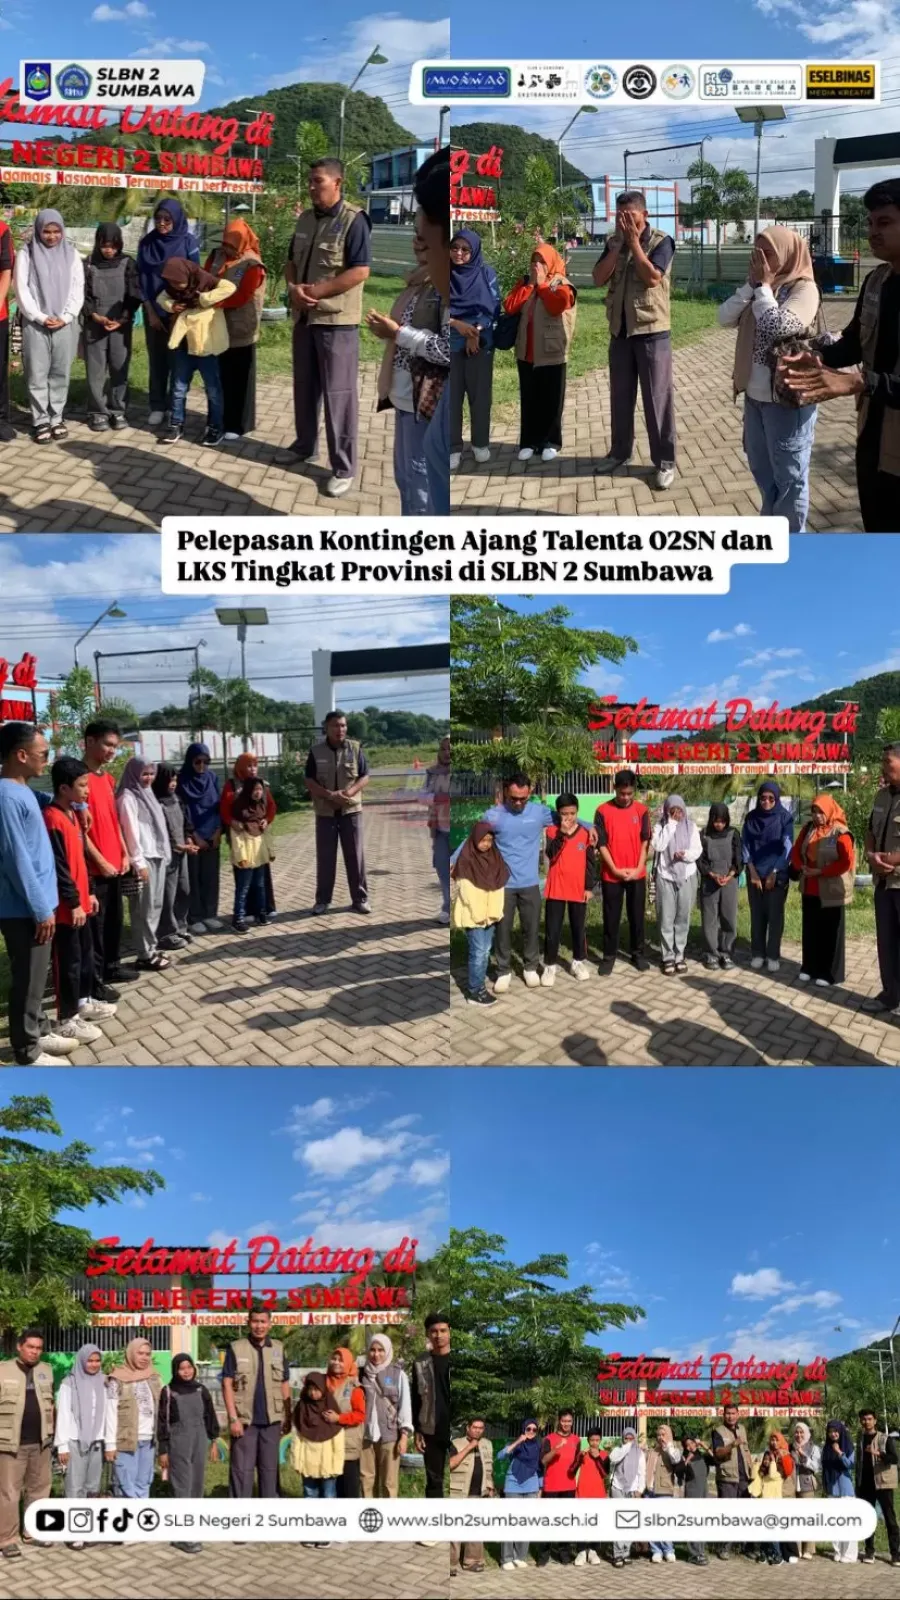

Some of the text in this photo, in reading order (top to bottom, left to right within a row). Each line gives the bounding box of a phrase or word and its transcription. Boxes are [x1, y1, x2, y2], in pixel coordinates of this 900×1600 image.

[245, 111, 275, 147] di
[12, 140, 264, 178] NEGERI 2 SUMBAWA
[476, 145, 504, 178] di
[56, 171, 122, 187] Nasionalis
[125, 175, 174, 192] Terampil
[178, 178, 199, 190] Asri
[588, 695, 859, 744] Selamat Datang di
[593, 740, 850, 761] SLB NEGERI 2 SUMBAWA
[635, 764, 674, 776] Agamais
[678, 764, 726, 775] Nasionalis
[774, 763, 792, 775] Asri
[86, 1235, 418, 1287] Selamat Datang di
[91, 1286, 410, 1311] SLB NEGERI 2 SUMBAWA
[139, 1313, 186, 1328] Agamais
[308, 1312, 331, 1325] Asri
[597, 1352, 828, 1390] Selamat Datang di
[644, 1389, 716, 1406] NEGERI
[721, 1388, 732, 1406] 2
[738, 1389, 822, 1406] SUMBAWA
